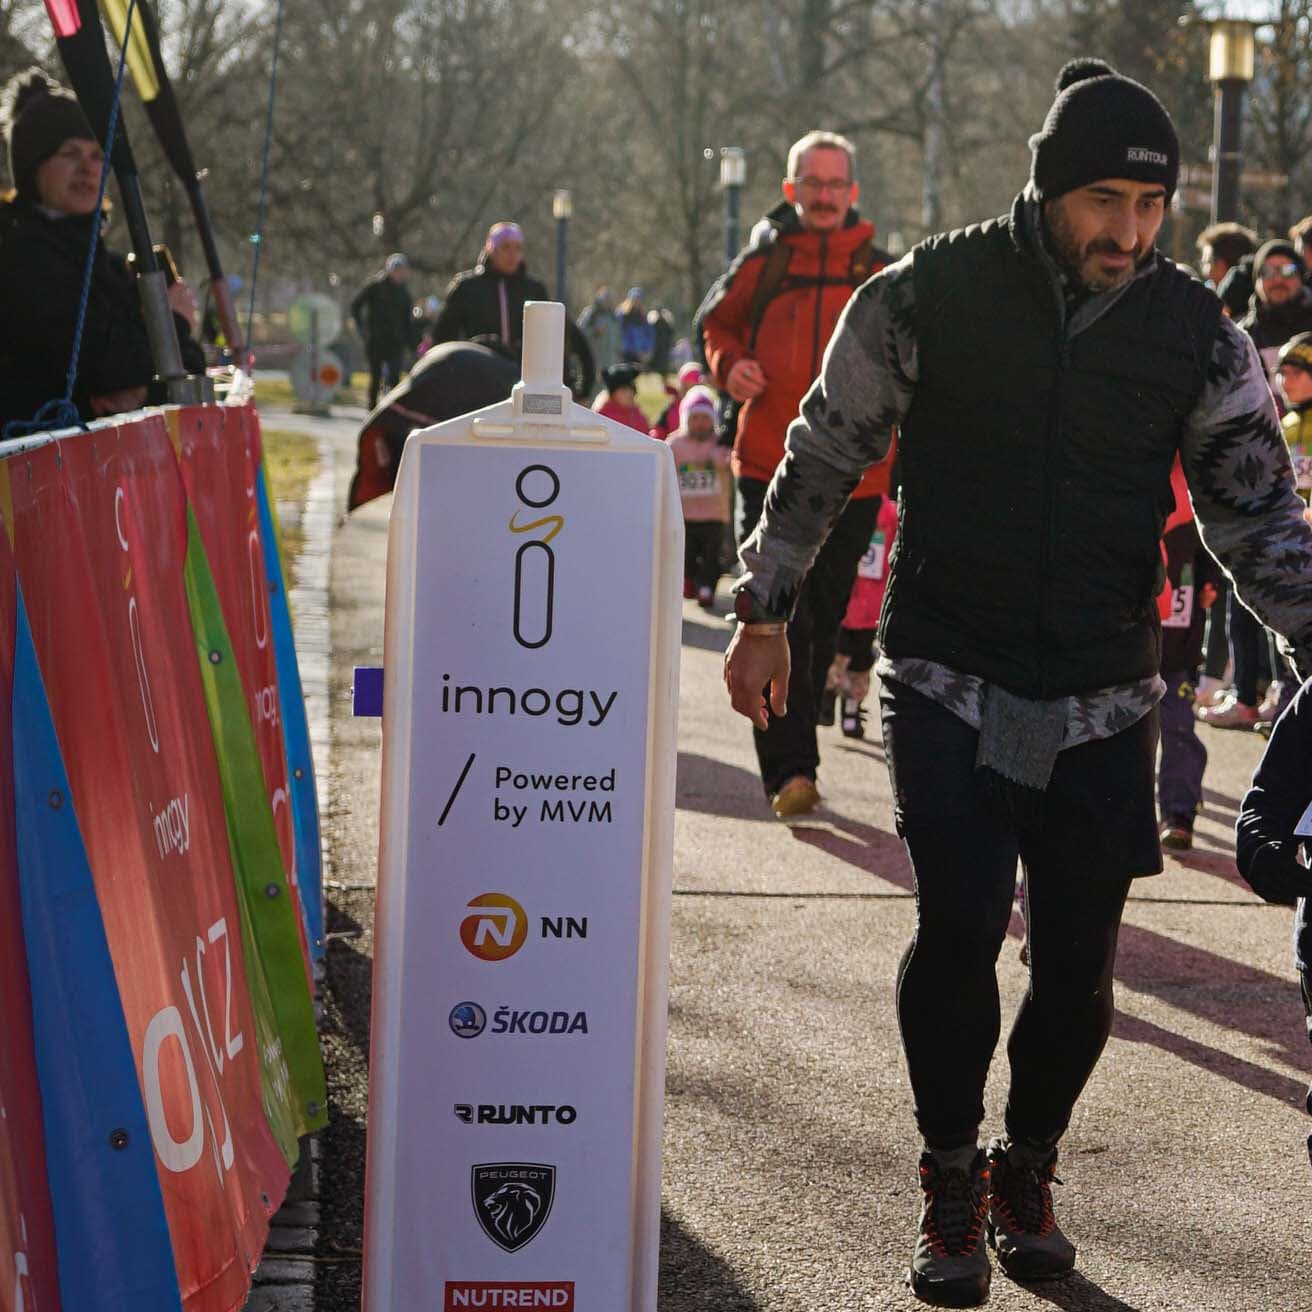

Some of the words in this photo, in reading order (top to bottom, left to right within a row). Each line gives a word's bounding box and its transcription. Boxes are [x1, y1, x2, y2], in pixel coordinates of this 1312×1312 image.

[441, 673, 618, 727] innogy
[495, 766, 616, 792] Powered
[494, 797, 528, 828] by
[540, 799, 613, 824] MVM
[540, 916, 588, 939] NN
[491, 1005, 589, 1034] ŠKODA
[477, 1104, 577, 1125] RUNTO
[479, 1170, 548, 1179] PEUGEOT
[452, 1288, 569, 1307] NUTREND
